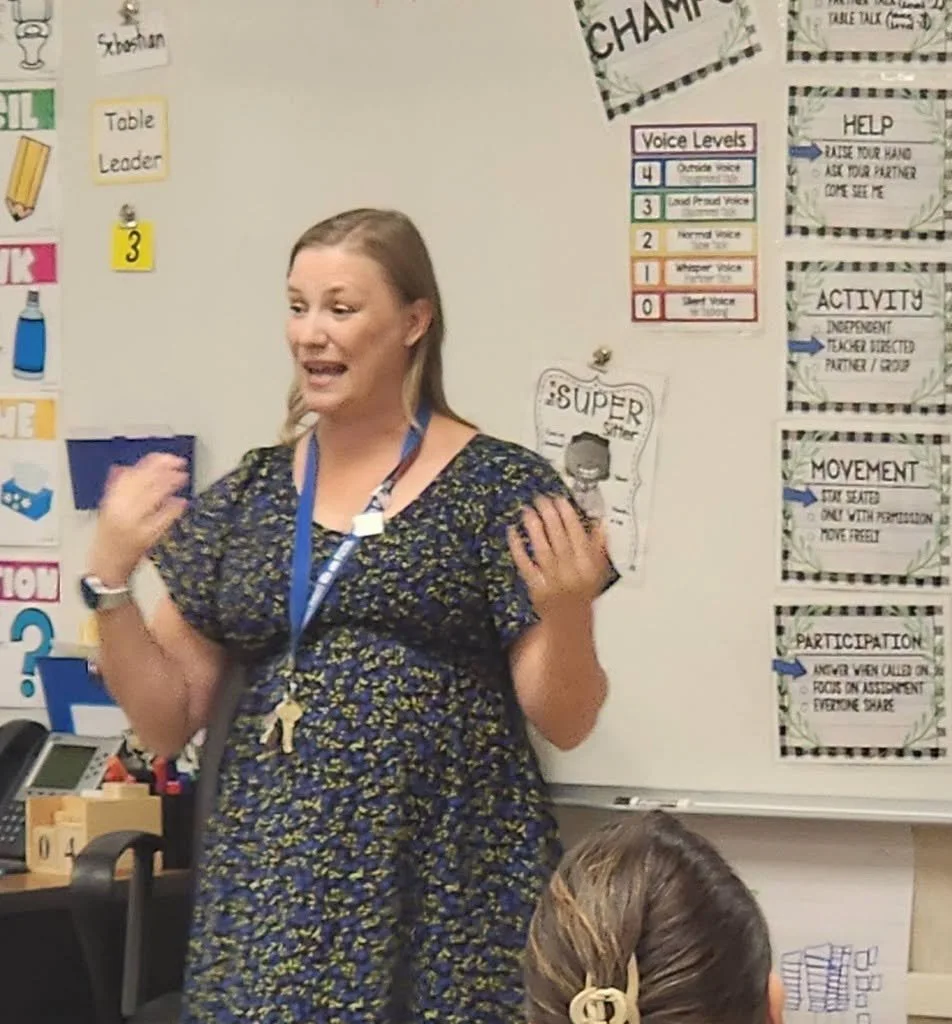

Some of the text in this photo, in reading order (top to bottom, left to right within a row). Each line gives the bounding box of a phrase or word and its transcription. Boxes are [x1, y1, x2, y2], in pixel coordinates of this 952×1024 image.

[587, 0, 734, 59] CHAM
[104, 110, 155, 131] Table
[844, 115, 893, 136] HELP
[642, 131, 746, 149] Voice Levels
[825, 145, 912, 160] RAISE YOUR HAND
[99, 151, 162, 174] Leader
[642, 166, 653, 183] 4
[825, 164, 916, 179] ASK YOUR PARTNER
[825, 184, 884, 199] COME SEE ME
[643, 199, 652, 216] 3
[126, 231, 142, 263] 3
[643, 231, 653, 249] 2
[642, 298, 653, 316] 0
[817, 288, 923, 311] ACTIVITY
[827, 320, 892, 334] INDEPENDENT
[827, 339, 915, 354] TEACHER DIRECTED
[825, 358, 866, 372] PARTNER
[880, 359, 910, 372] GROUP
[557, 384, 644, 425] SUPER
[811, 458, 919, 482] MOVEMENT
[822, 489, 880, 505] STAY SEATED
[821, 509, 933, 525] ONLY WITH PERMISSION
[820, 528, 846, 542] MOVE
[0, 566, 57, 599] ION
[796, 633, 922, 650] PARTICIPATION
[813, 664, 929, 677] ANSWER WHEN CALLED ON
[813, 681, 924, 695] FOCUS ON ASSIGNMENT
[814, 699, 895, 712] EVERYONE SHARE
